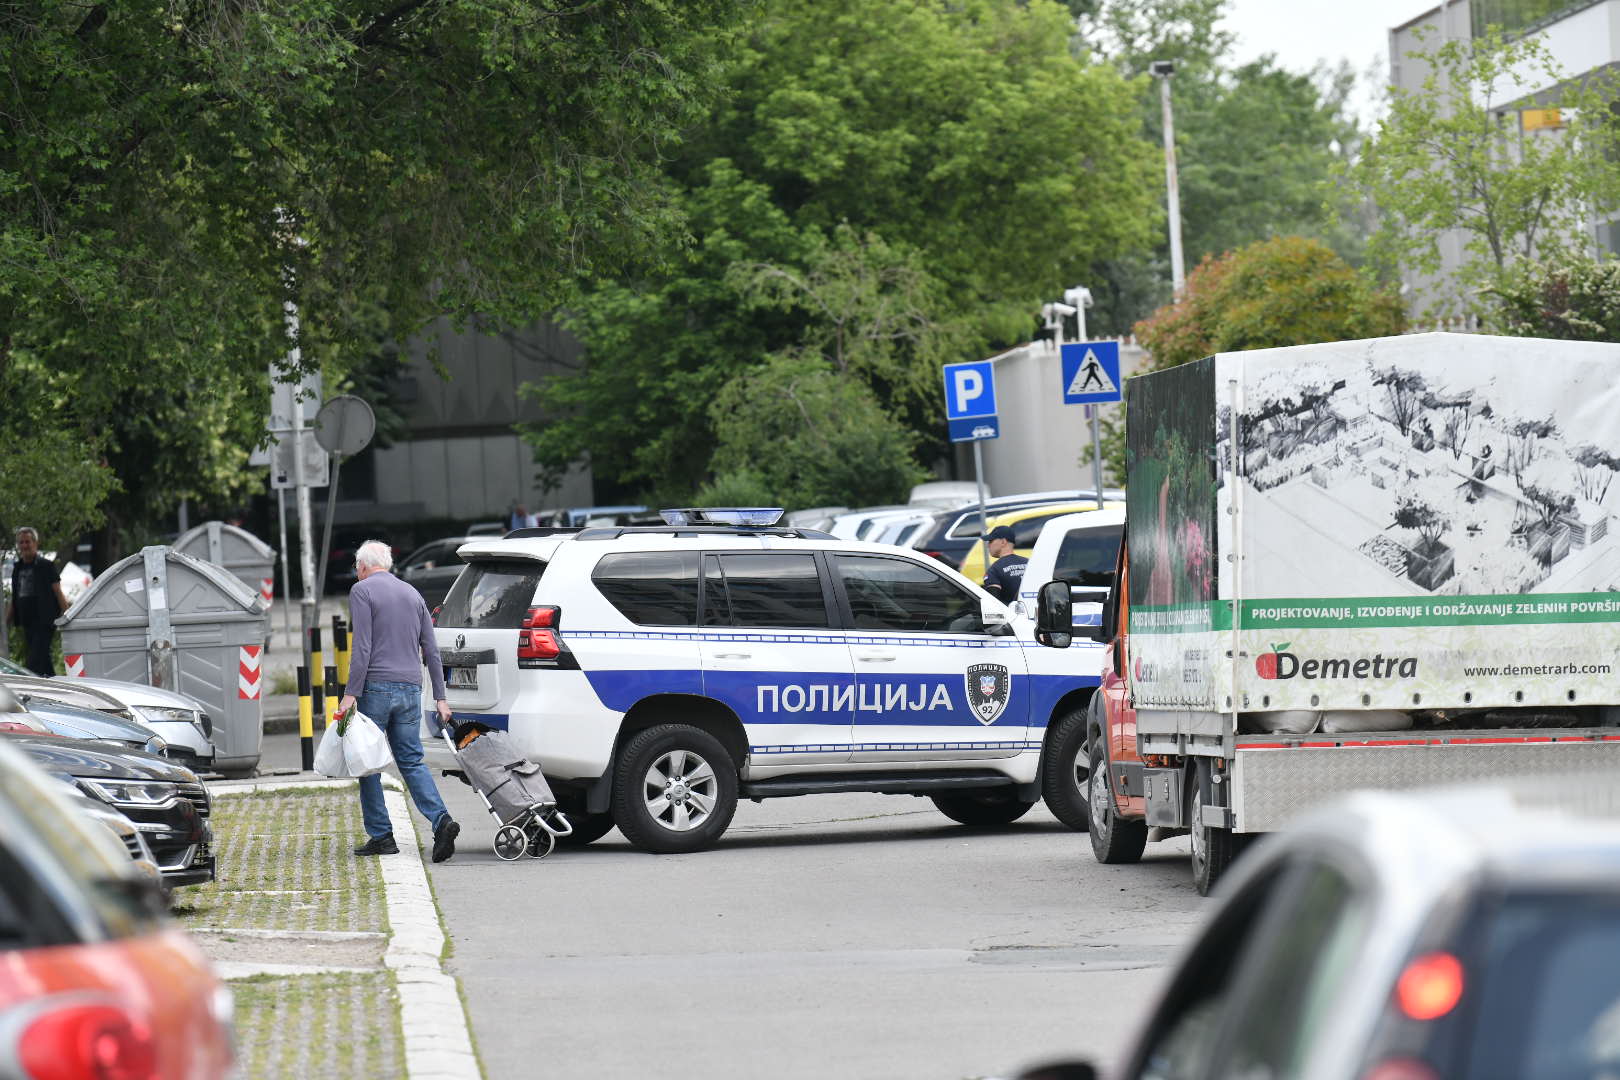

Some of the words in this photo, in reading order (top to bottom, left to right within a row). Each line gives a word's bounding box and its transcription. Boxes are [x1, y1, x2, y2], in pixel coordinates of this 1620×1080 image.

[954, 369, 983, 412] P
[1252, 607, 1354, 619] PROJEKTOVANJE,
[1357, 606, 1423, 618] IZVOĐENJE
[1425, 606, 1430, 616] I
[1432, 602, 1513, 616] ODRŽAVANJE
[1515, 602, 1567, 614] ZELENIH
[1276, 652, 1418, 680] Demetra
[1464, 663, 1611, 677] www.demetrarb.com
[757, 683, 953, 714] ПОЛИЦИЈА
[982, 706, 993, 714] 92
